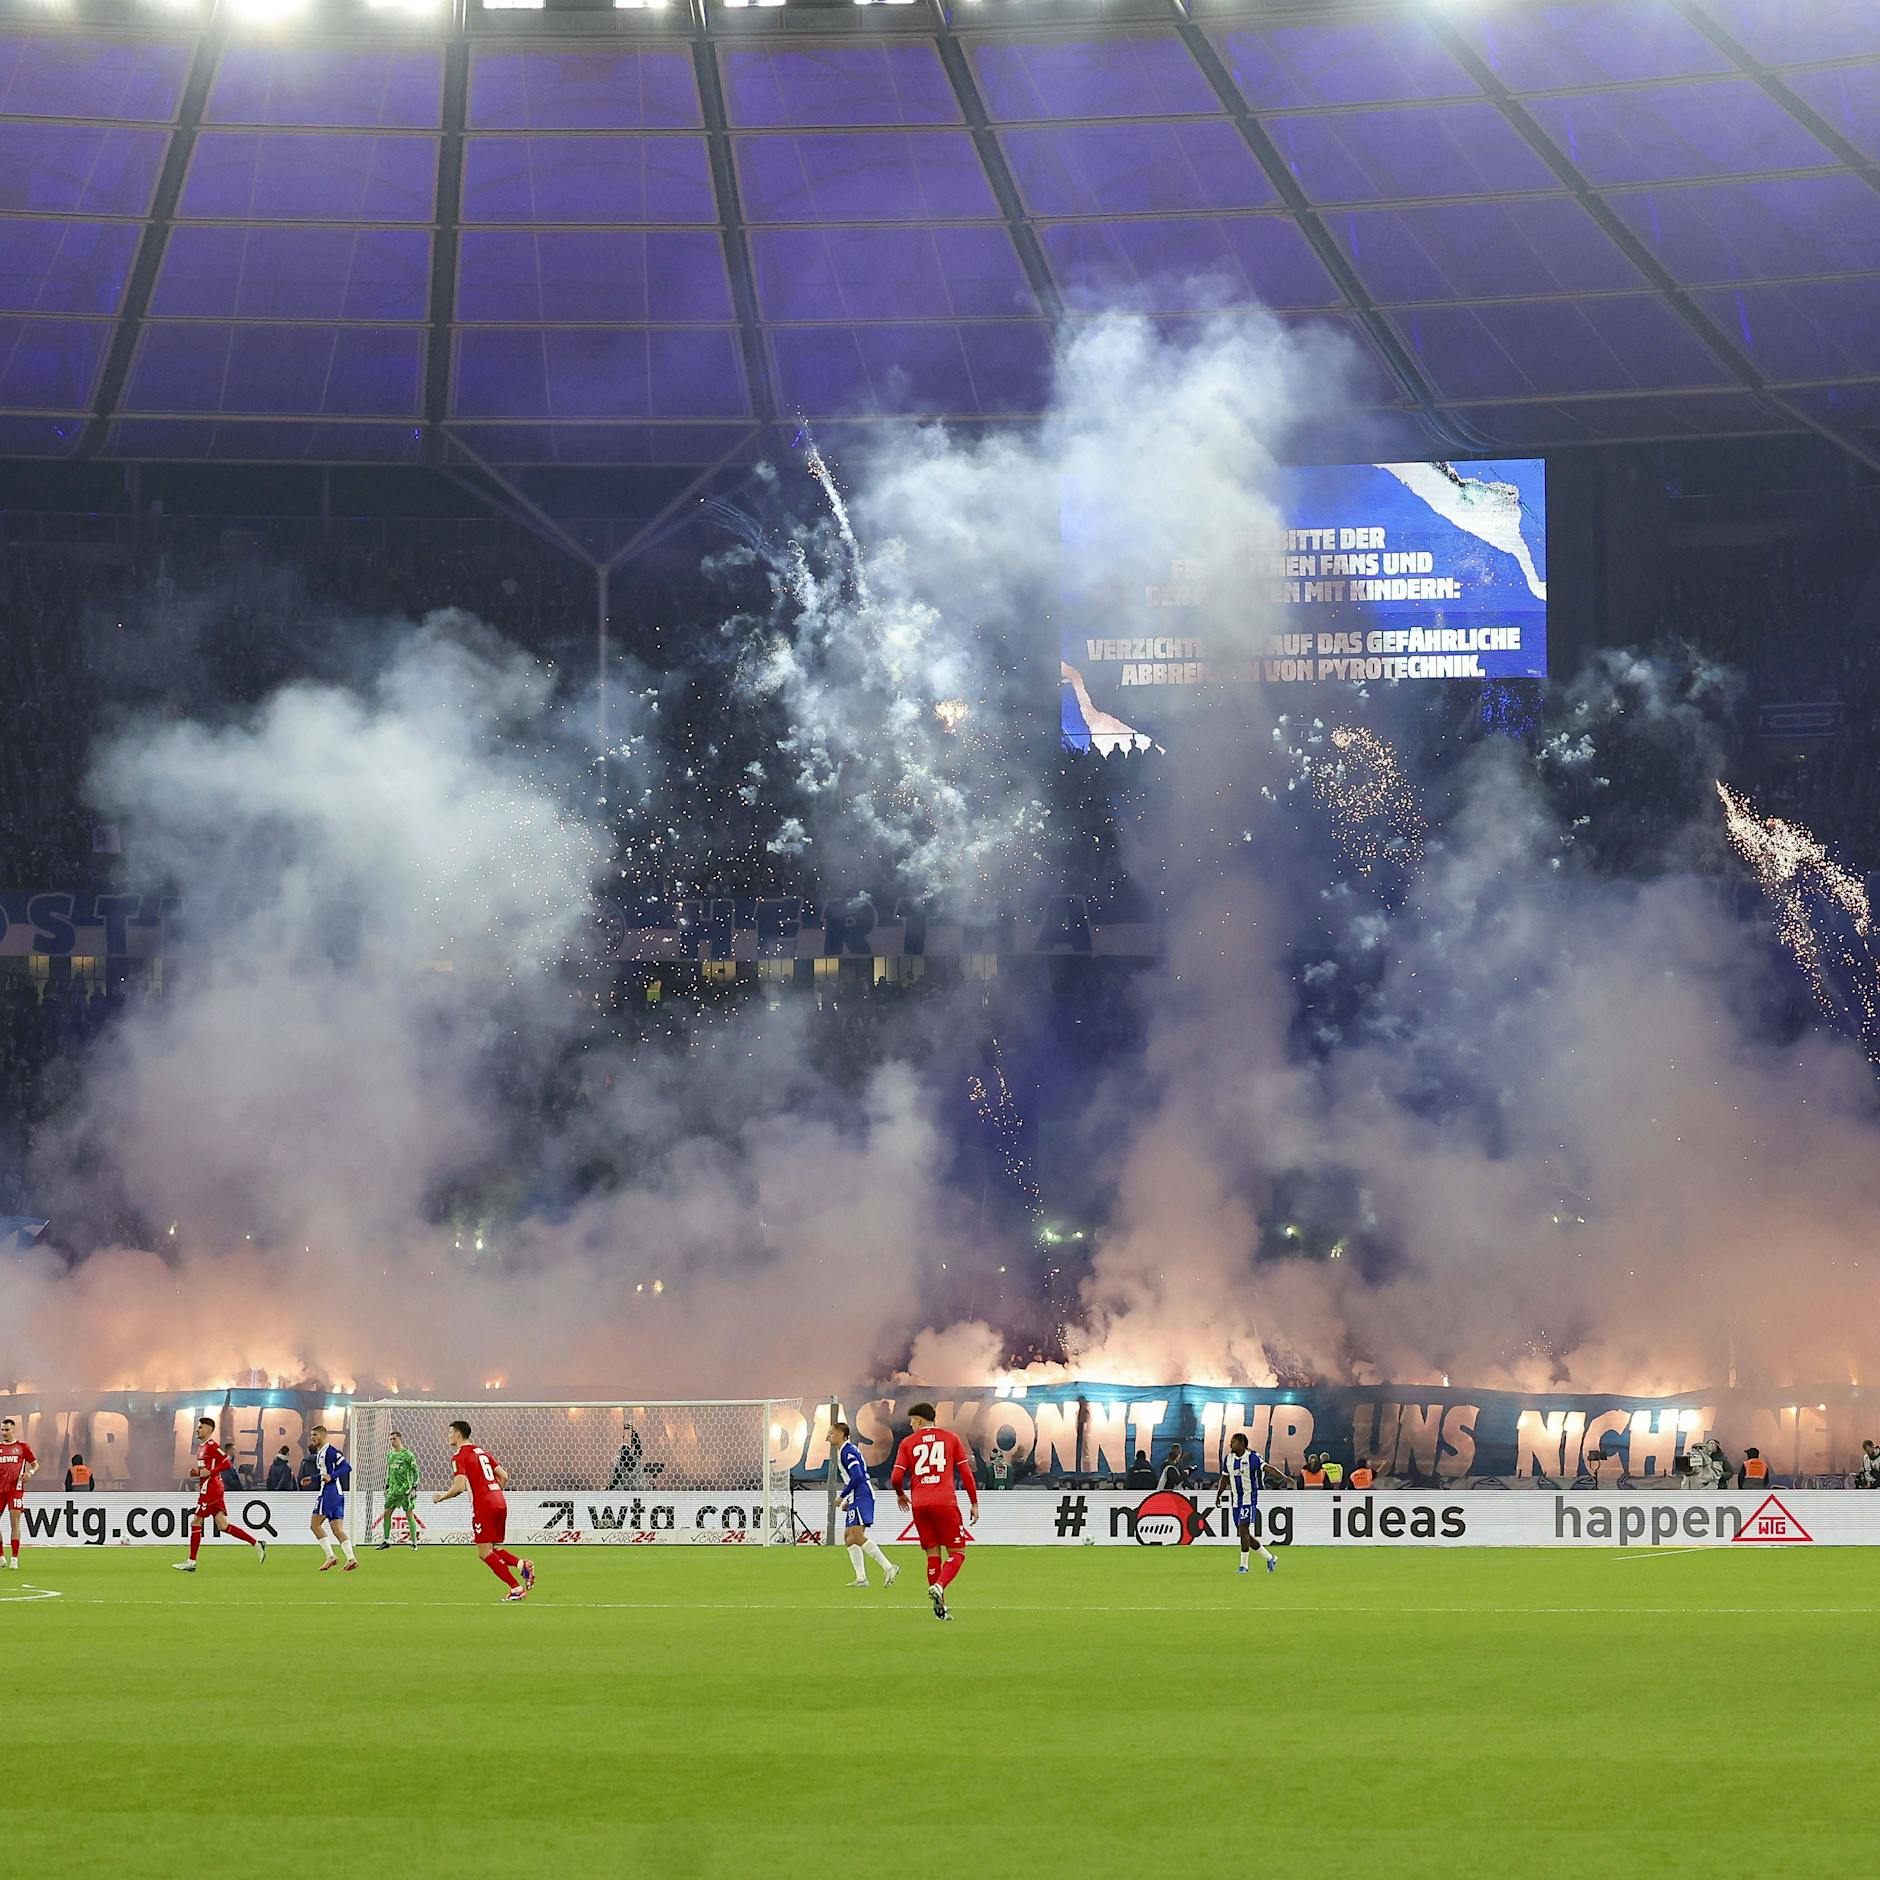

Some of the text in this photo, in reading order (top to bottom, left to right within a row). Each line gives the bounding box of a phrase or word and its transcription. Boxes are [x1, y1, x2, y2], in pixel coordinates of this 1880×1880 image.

[1339, 527, 1386, 550] DER
[1320, 553, 1380, 576] FANS
[1382, 551, 1434, 576] UND
[1304, 579, 1346, 603] MIT
[1350, 577, 1461, 602] KINDERN:
[1269, 633, 1314, 656] AUF
[1317, 631, 1363, 655] DAS
[1366, 626, 1521, 654] GEFÄHRLICHE
[1264, 658, 1314, 682] VON
[1319, 654, 1486, 681] PYROTECHNIK.
[766, 1399, 896, 1473] DAS
[930, 1387, 1168, 1476] KÖNNT
[1200, 1401, 1315, 1477] IHR
[1353, 1401, 1481, 1477] UNS
[1516, 1406, 1717, 1478] NICHT
[478, 1454, 495, 1482] 6
[912, 1440, 947, 1476] 24
[1109, 1496, 1293, 1546] mking
[1333, 1496, 1466, 1538] ideas
[1555, 1496, 1741, 1546] happen
